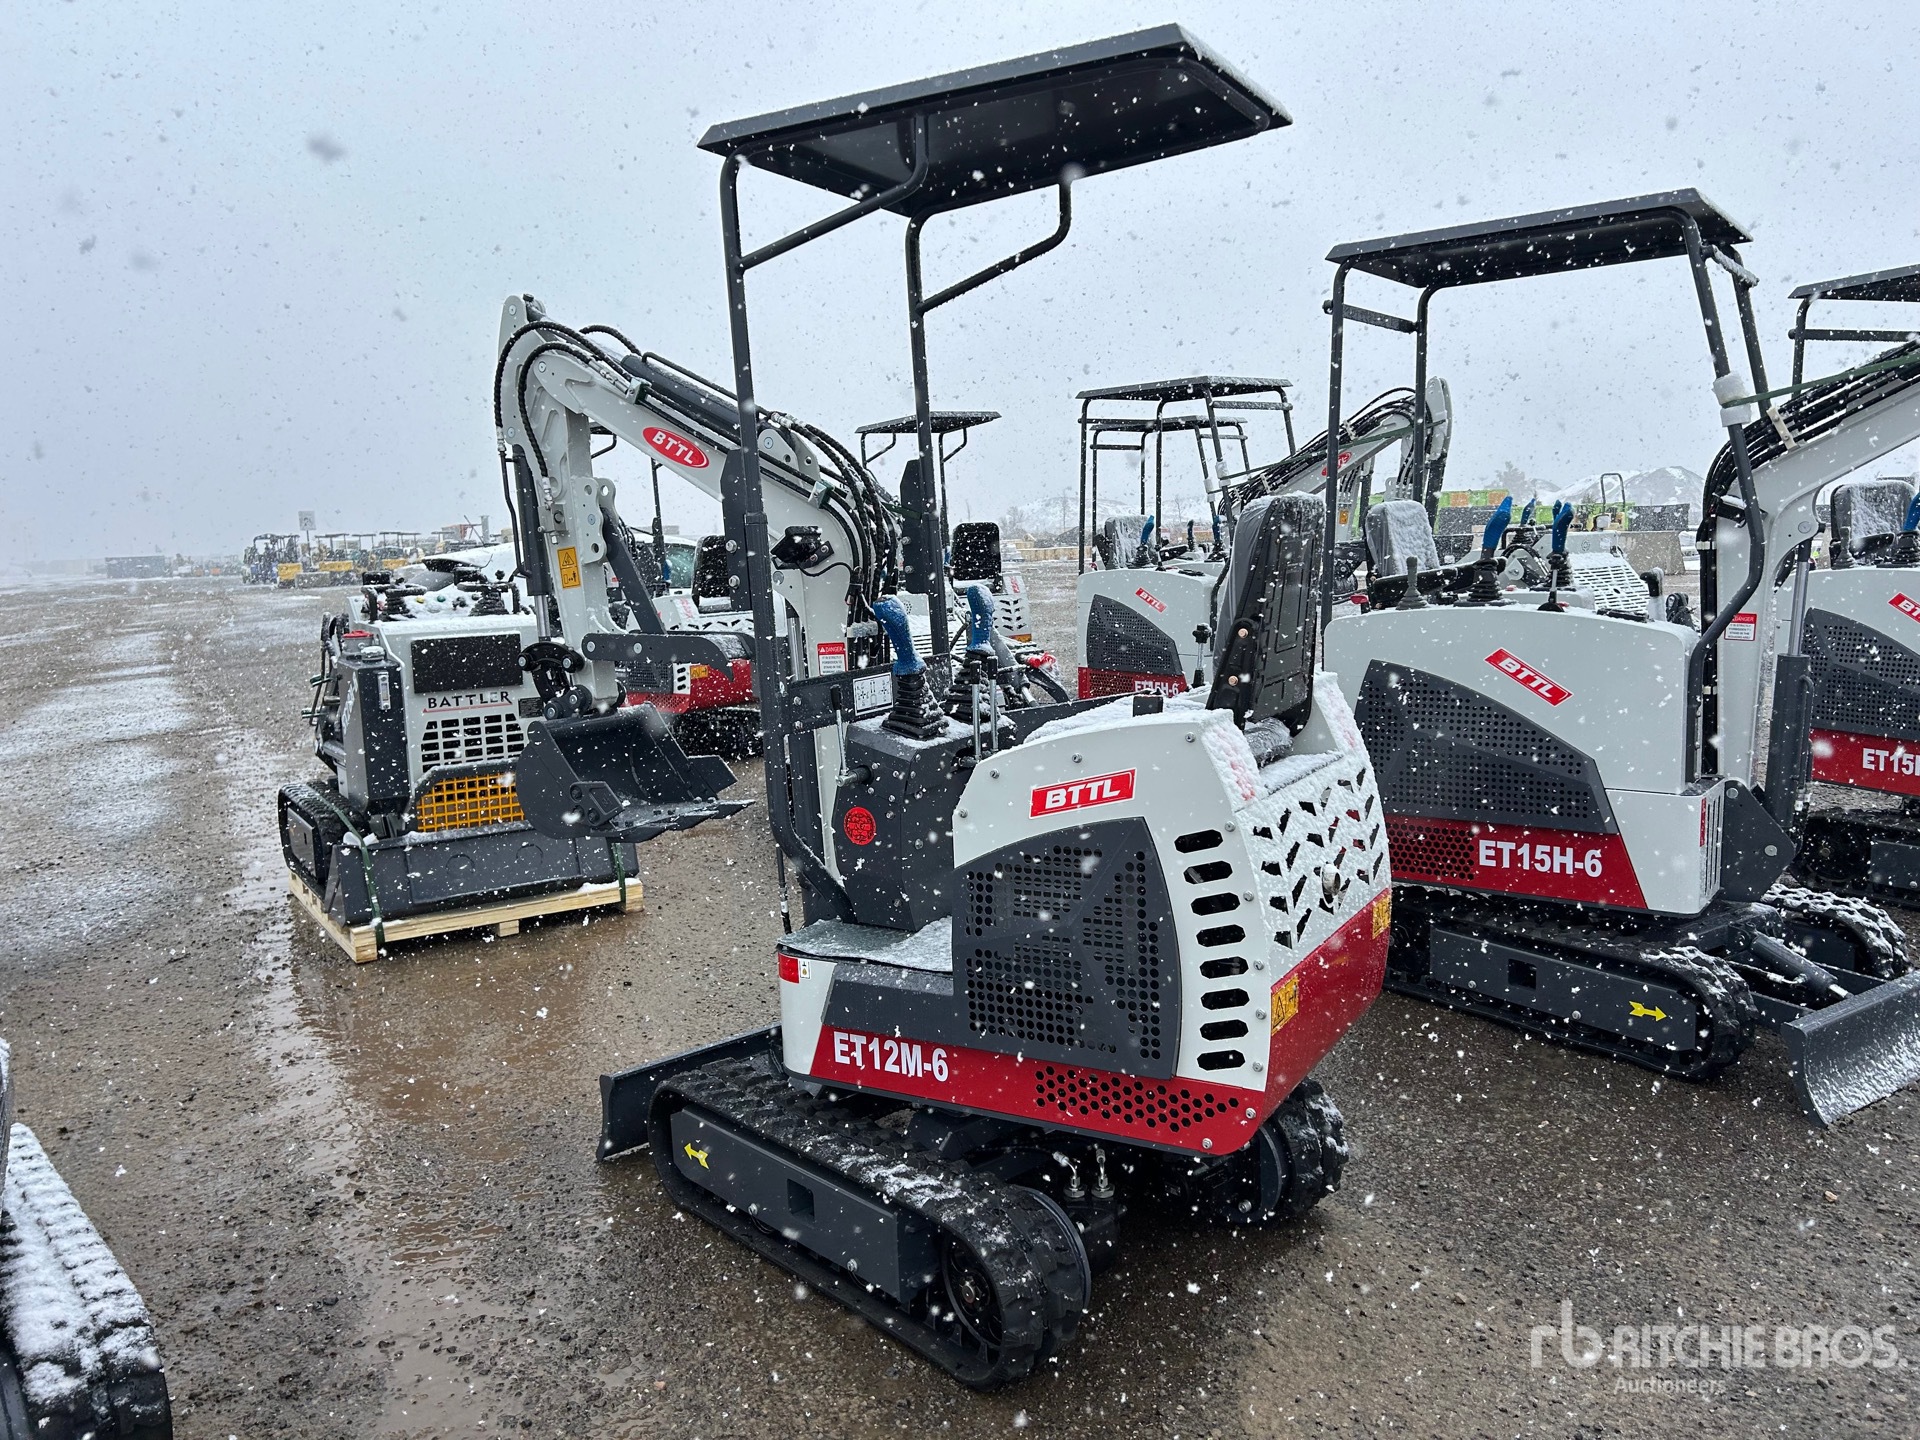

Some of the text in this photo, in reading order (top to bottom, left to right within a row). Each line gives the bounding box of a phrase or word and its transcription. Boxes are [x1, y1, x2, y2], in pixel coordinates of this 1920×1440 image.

[652, 430, 694, 465] BTTL
[1139, 590, 1162, 610] BTTL
[1498, 657, 1553, 698] BTTL
[428, 691, 512, 708] BATTLER
[1045, 779, 1121, 809] BTTL
[1479, 839, 1603, 878] ET15H-6
[834, 1031, 949, 1082] ET12M-6
